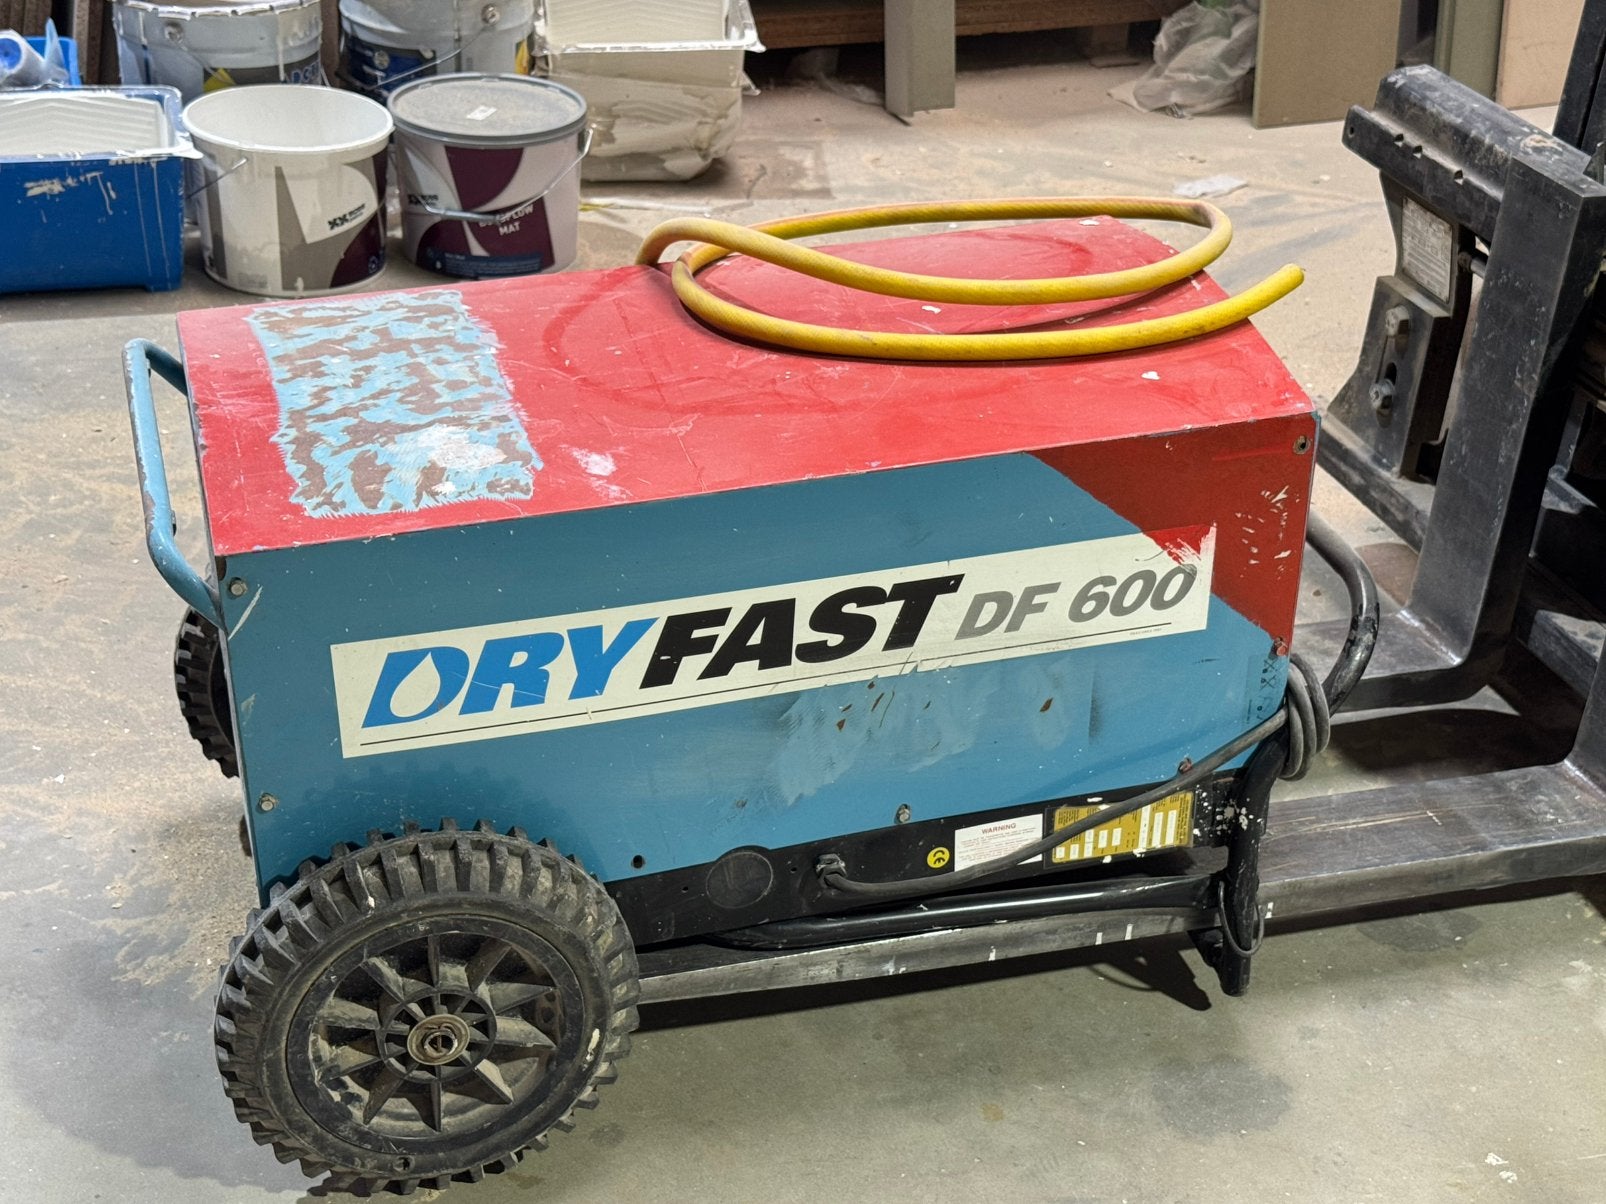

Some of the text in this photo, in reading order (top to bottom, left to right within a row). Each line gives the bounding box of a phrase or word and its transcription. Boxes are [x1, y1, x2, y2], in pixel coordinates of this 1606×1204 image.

[499, 221, 521, 236] MAT
[361, 564, 1197, 729] DRYFAST DF 600
[981, 822, 1017, 834] WARNING
